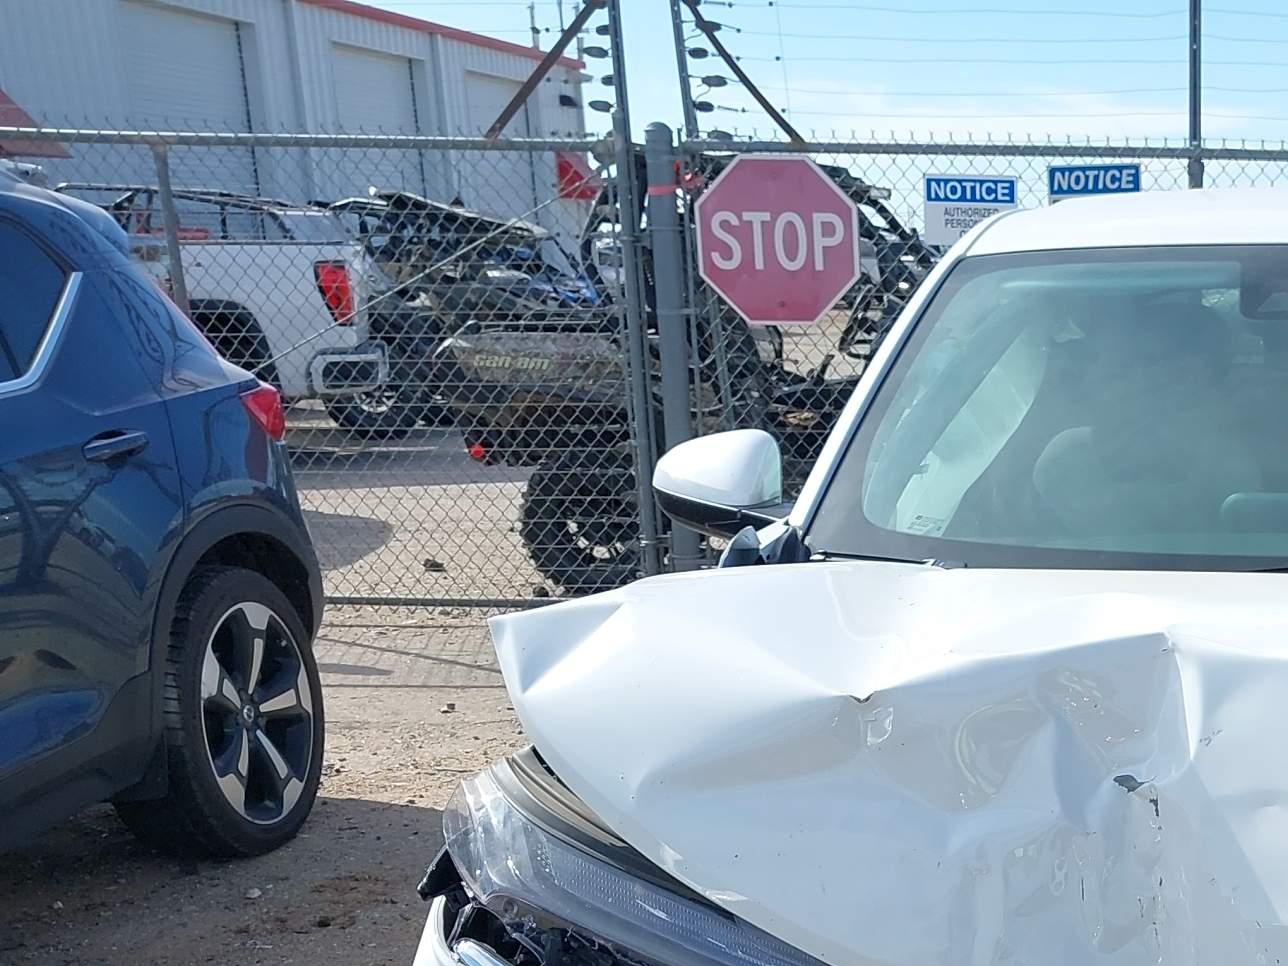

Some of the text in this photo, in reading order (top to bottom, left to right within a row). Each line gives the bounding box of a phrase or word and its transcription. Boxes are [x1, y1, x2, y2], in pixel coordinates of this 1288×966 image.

[929, 180, 1011, 201] NOTICE
[1053, 168, 1135, 191] NOTICE
[710, 210, 846, 272] STOP
